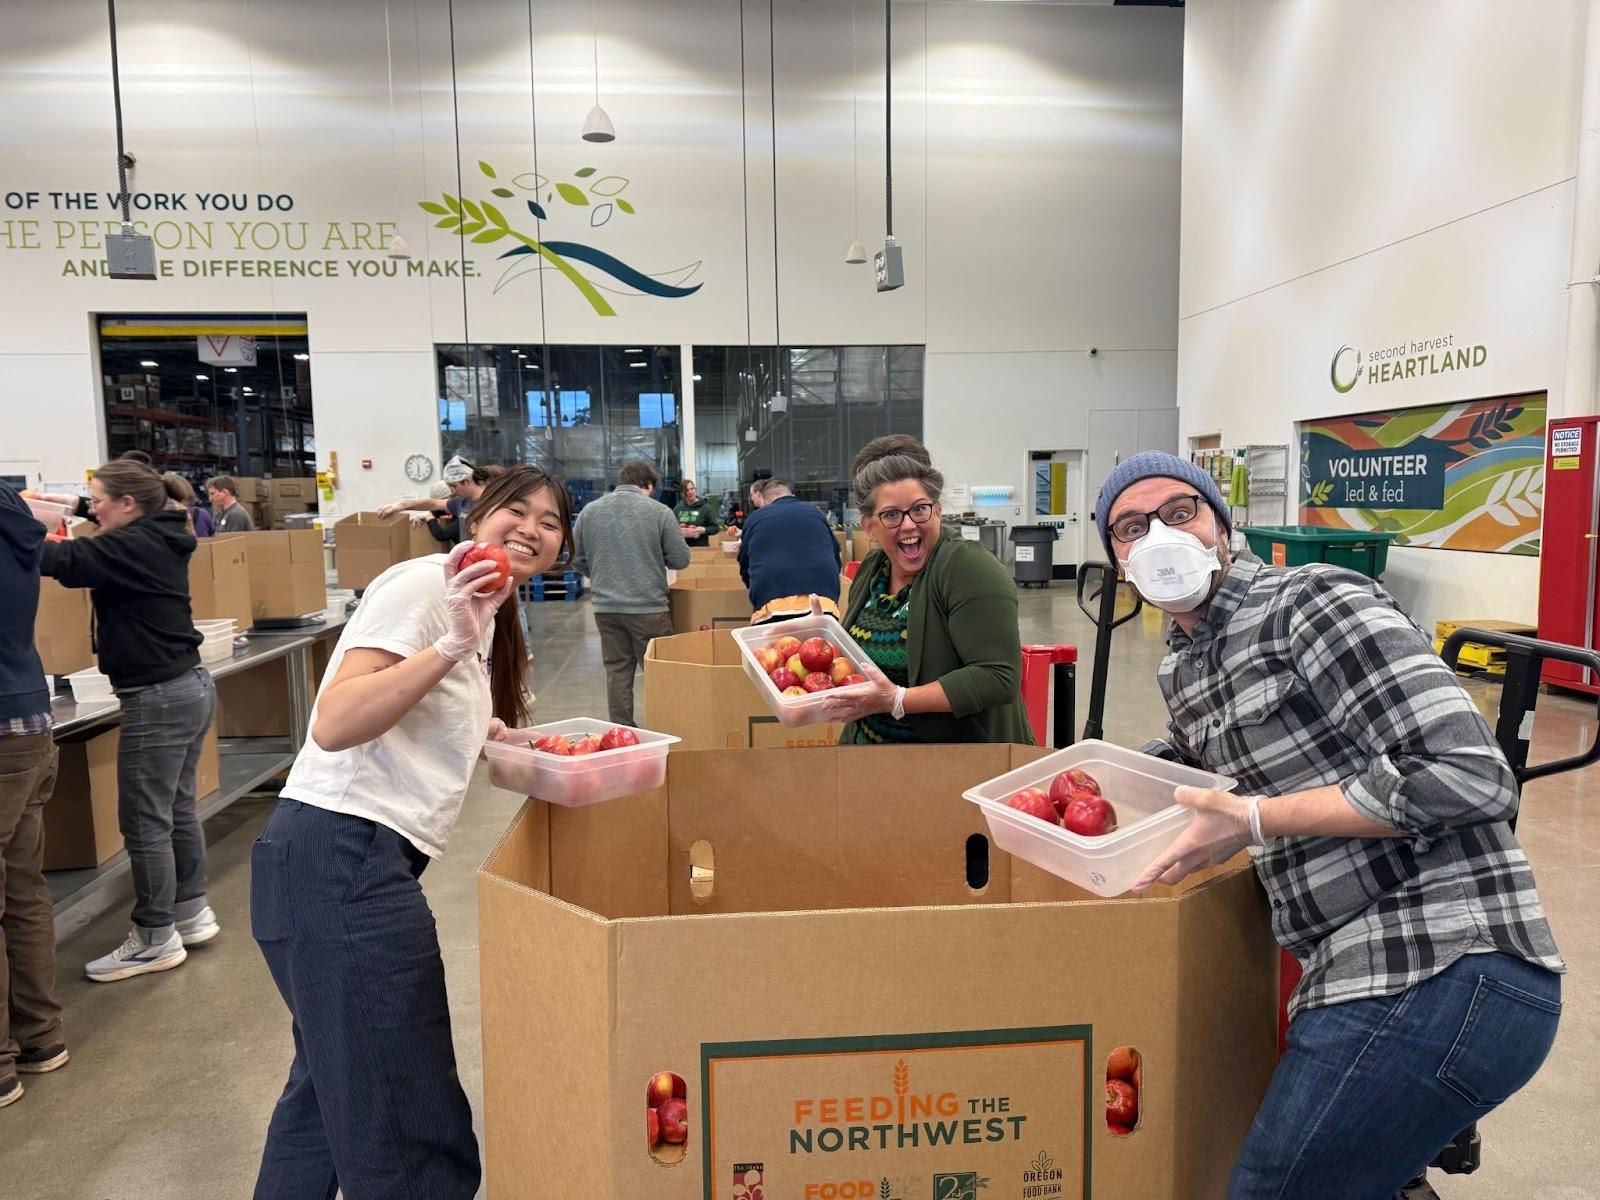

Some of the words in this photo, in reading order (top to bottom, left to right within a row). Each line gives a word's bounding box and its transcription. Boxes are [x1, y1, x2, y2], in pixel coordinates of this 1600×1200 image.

[5, 192, 39, 209] OF
[48, 192, 98, 210] THE
[107, 193, 187, 210] WORK
[196, 193, 248, 211] YOU
[257, 194, 293, 211] DO
[225, 221, 308, 250] YOU
[183, 260, 338, 277] DIFFERENCE
[347, 260, 397, 277] YOU
[407, 260, 481, 277] MAKE.
[1369, 342, 1406, 361] second
[1411, 333, 1454, 354] harvest
[1368, 345, 1487, 385] HEARTLAND
[1554, 430, 1580, 439] NOTICE
[1328, 454, 1428, 478] VOLUNTEER
[1345, 481, 1365, 502] led
[1368, 484, 1378, 501] &
[1382, 480, 1404, 502] fed
[1156, 567, 1176, 576] 3M
[795, 1091, 960, 1124] FEEDING
[967, 1097, 1010, 1114] THE
[790, 1115, 1027, 1154] NORTHWEST
[1023, 1169, 1063, 1183] OREGON
[804, 1181, 876, 1200] FOOD
[1023, 1186, 1041, 1198] FOOD
[1043, 1184, 1062, 1195] BANK
